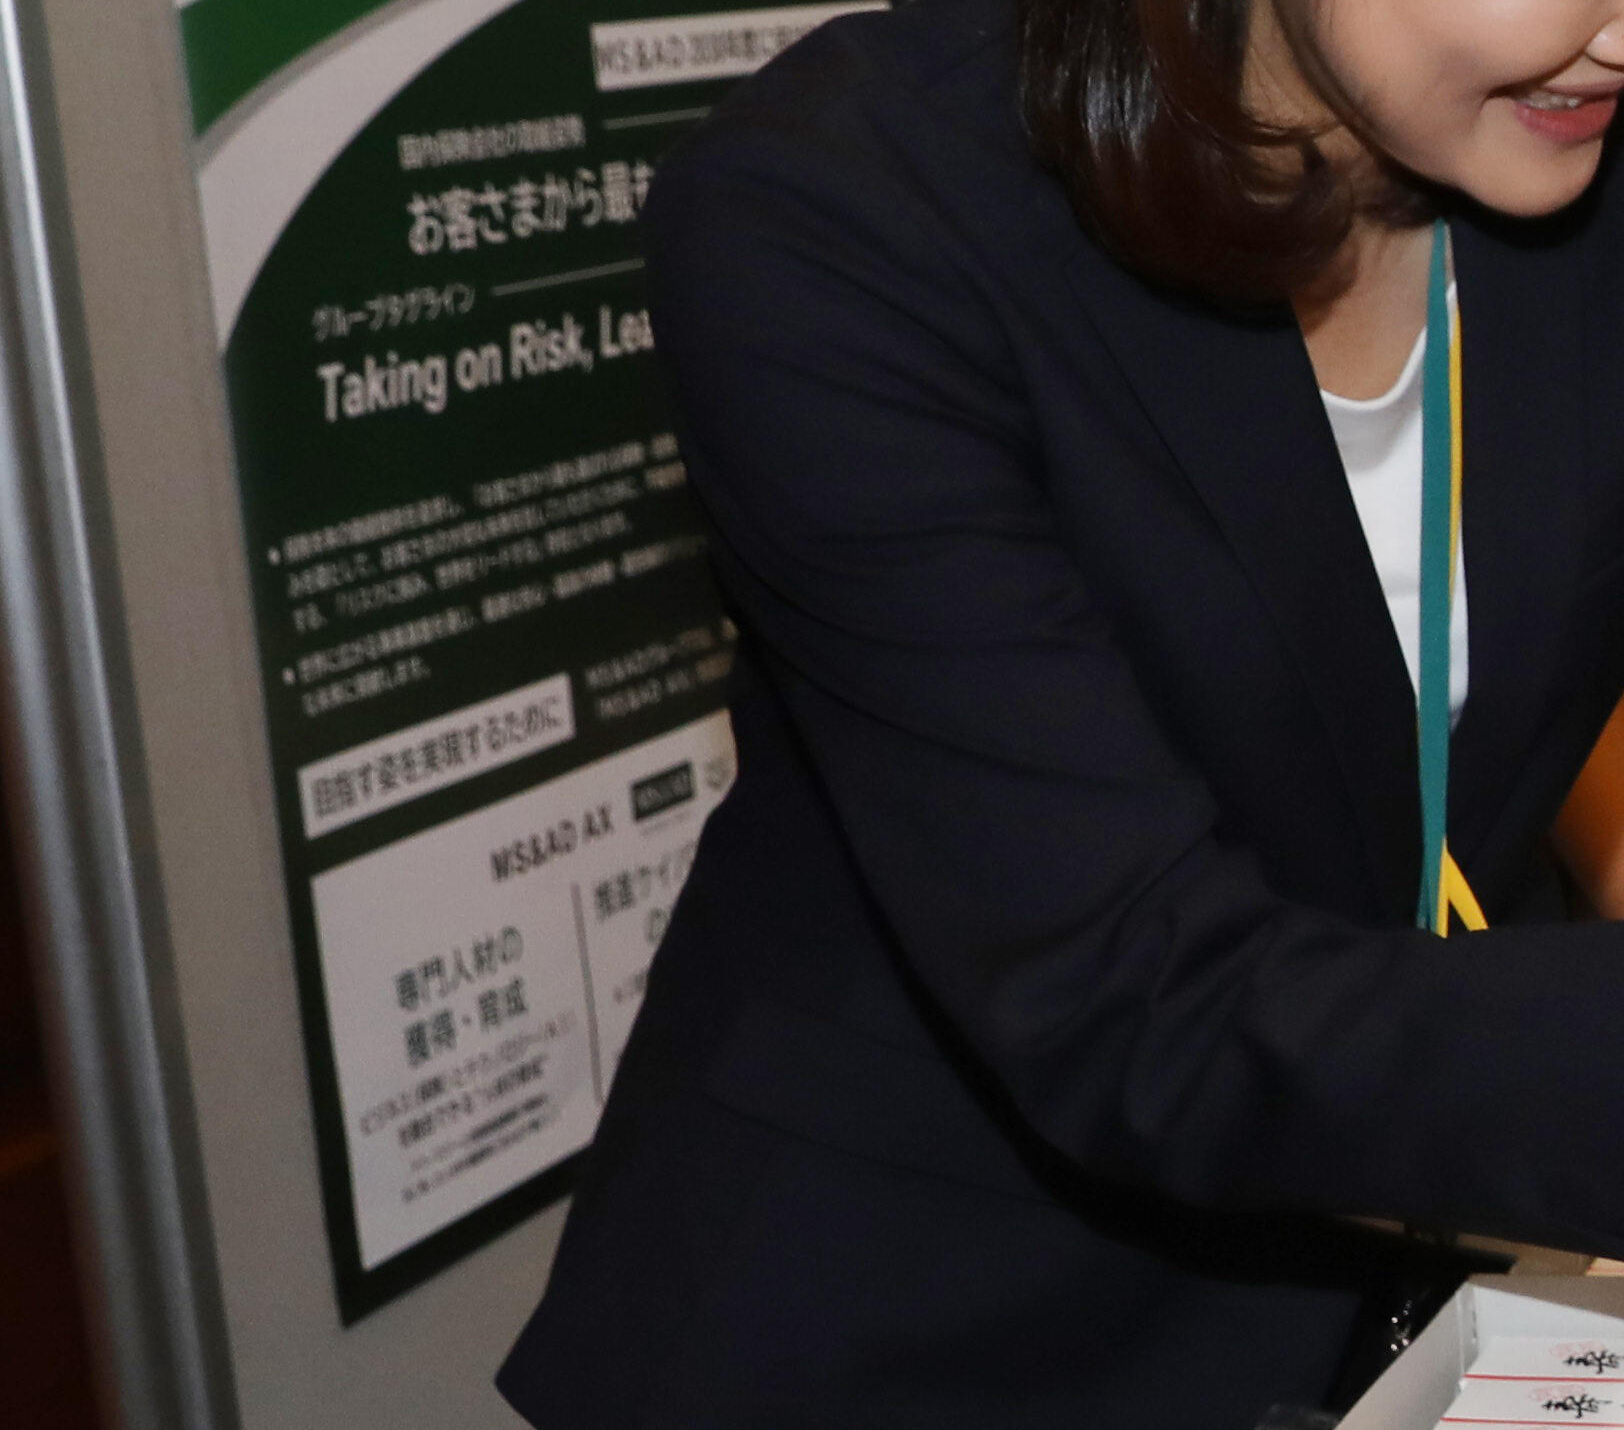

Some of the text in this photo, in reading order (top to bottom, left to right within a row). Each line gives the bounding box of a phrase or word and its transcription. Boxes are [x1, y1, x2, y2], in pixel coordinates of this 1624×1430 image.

[311, 282, 476, 342] グループタグライン
[318, 351, 447, 422] Taking
[456, 343, 502, 391] on
[510, 313, 593, 379] Risk,
[311, 695, 561, 818] 目指す姿を実現するために
[491, 821, 577, 880] MS&AD
